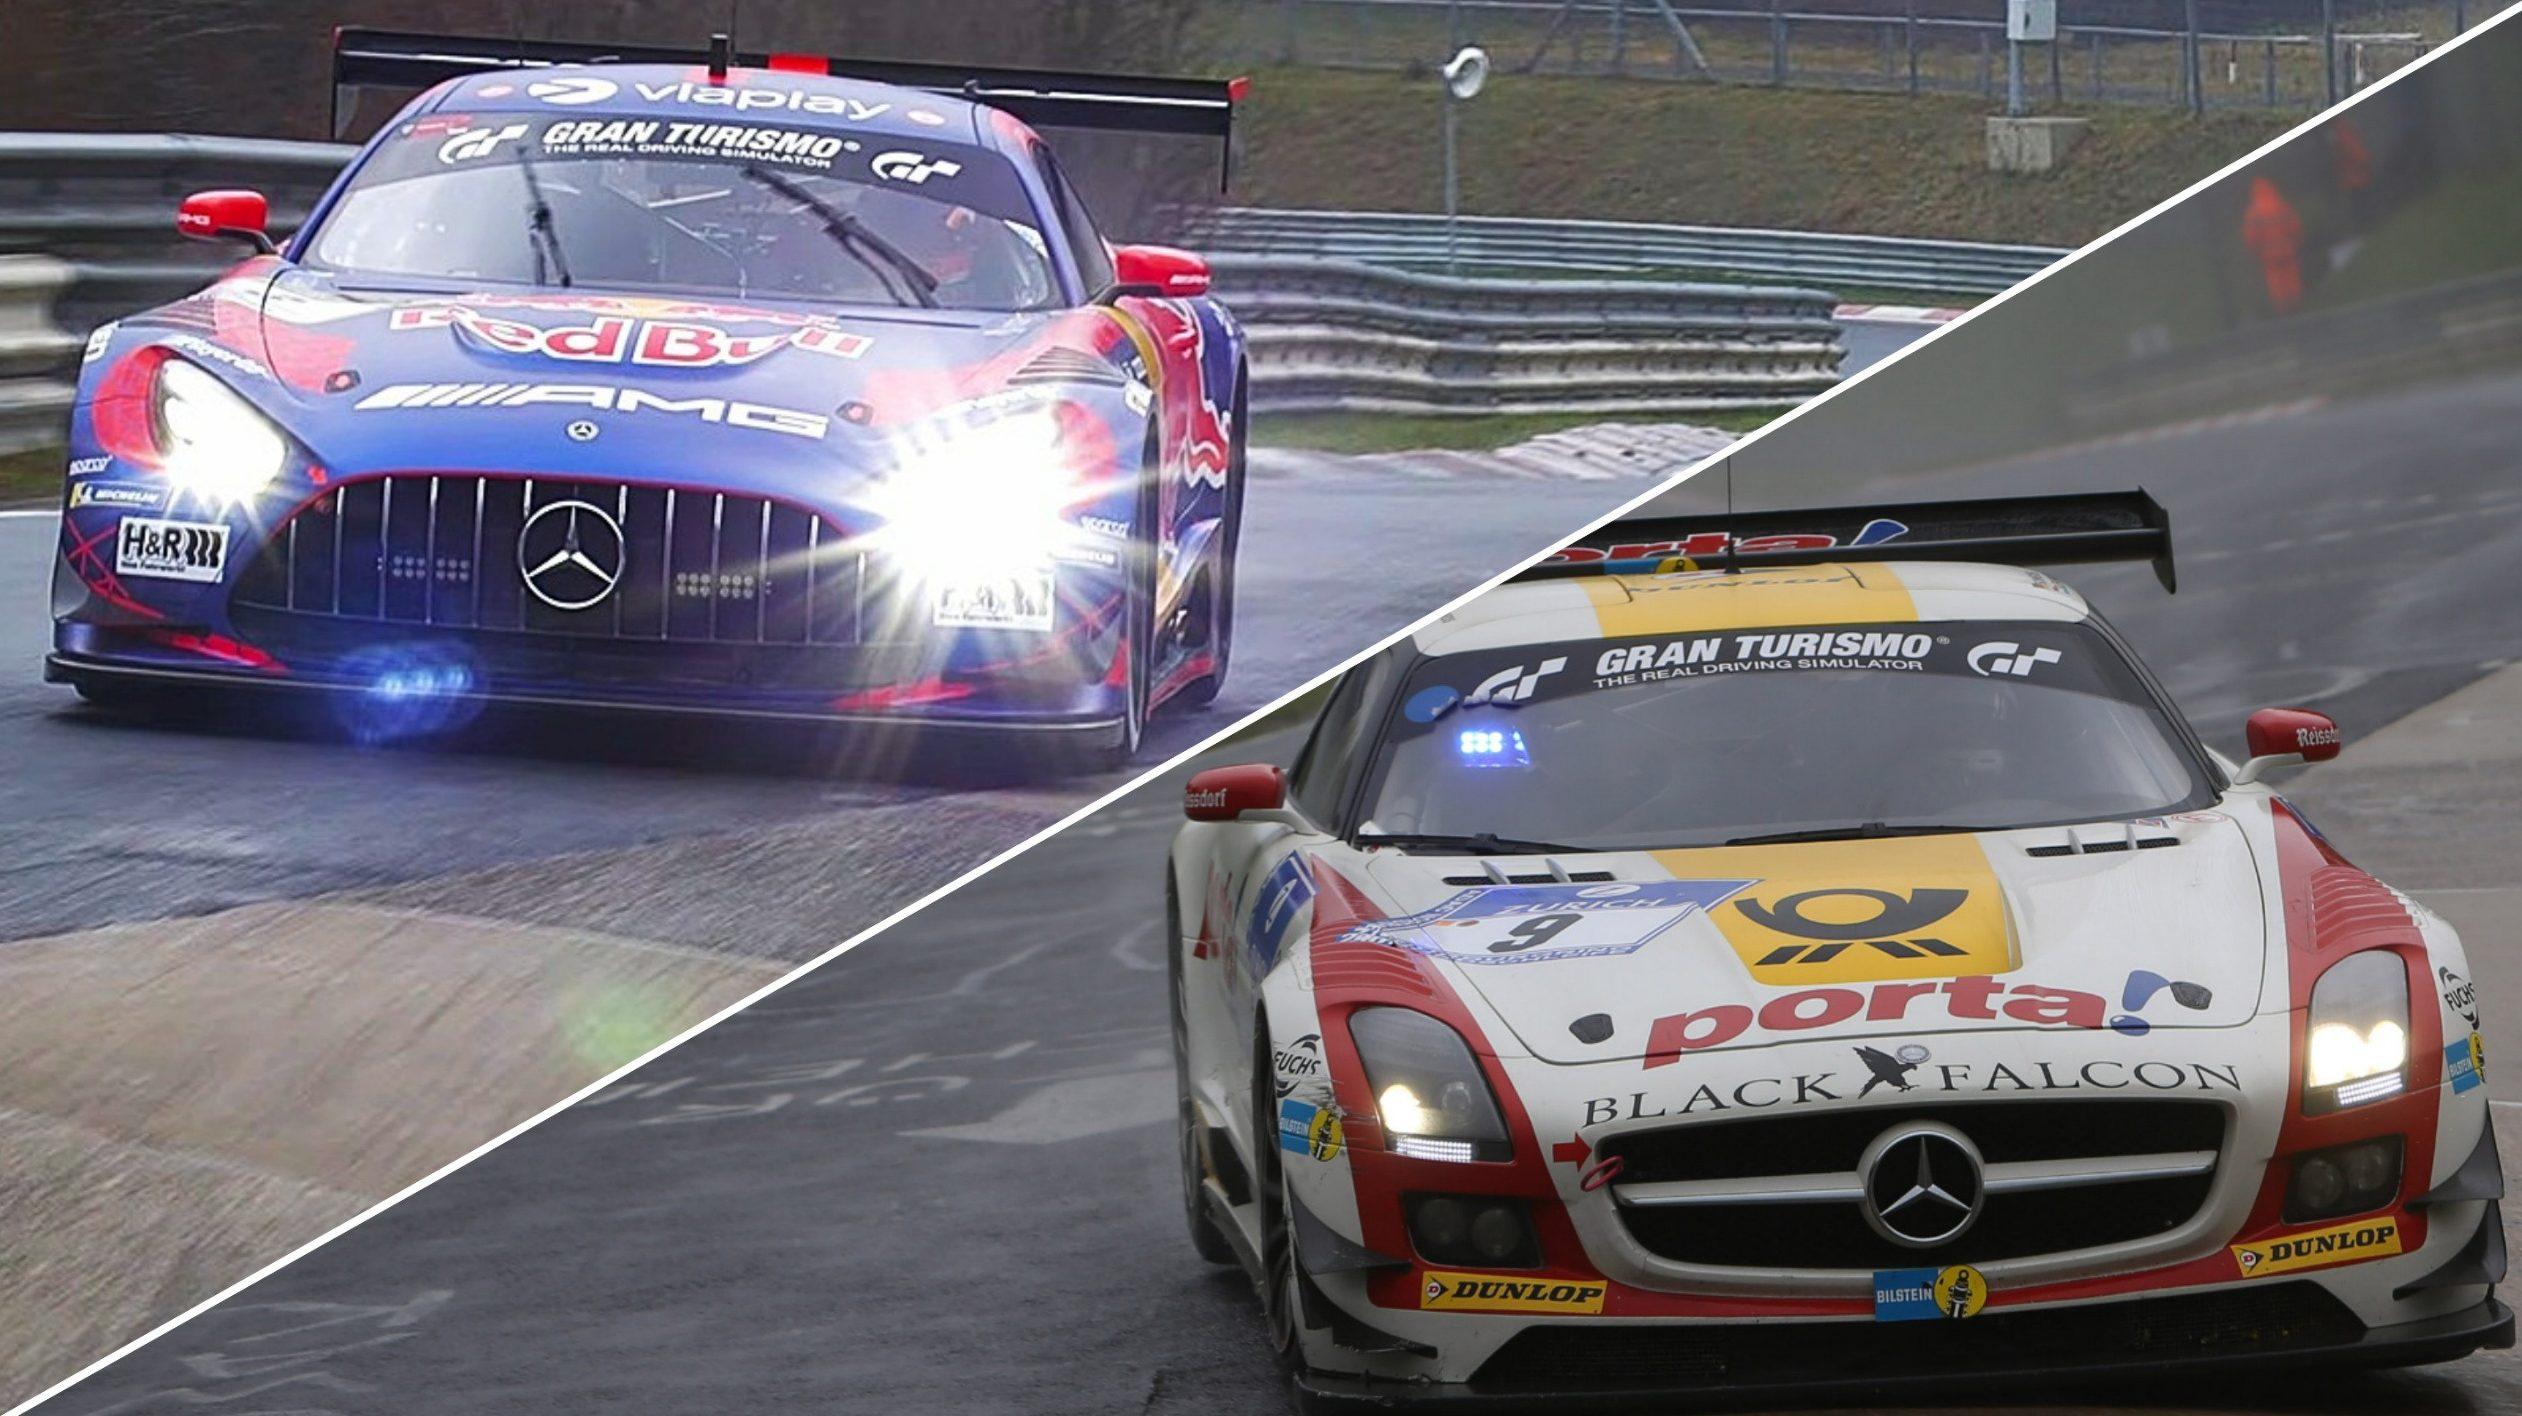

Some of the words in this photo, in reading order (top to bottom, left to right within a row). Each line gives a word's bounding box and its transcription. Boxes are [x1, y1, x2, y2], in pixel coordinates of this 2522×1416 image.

[635, 81, 891, 121] viaplay
[542, 121, 658, 144] GRAN
[544, 143, 580, 154] THE
[584, 143, 635, 154] REAL
[637, 143, 717, 157] DRIVING
[720, 147, 831, 169] SIMULATOR
[390, 308, 624, 363] Red
[631, 314, 876, 367] Bull
[122, 522, 182, 560] H&R
[1596, 636, 1722, 677] GRAN
[1593, 673, 1637, 690] THE
[1641, 667, 1699, 683] REAL
[1703, 659, 1792, 675] DRIVING
[1798, 658, 1924, 672] SIMULATOR
[1486, 913, 1585, 953] 9
[2443, 981, 2476, 1012] FUCHS
[1274, 1051, 1322, 1076] FUCHS
[1581, 1071, 1845, 1128] BLACK
[1933, 1059, 2245, 1093] FALCON
[2269, 1225, 2395, 1262] DUNLOP
[1451, 1281, 1603, 1303] DUNLOP
[1876, 1287, 1933, 1304] BILSTEIN
